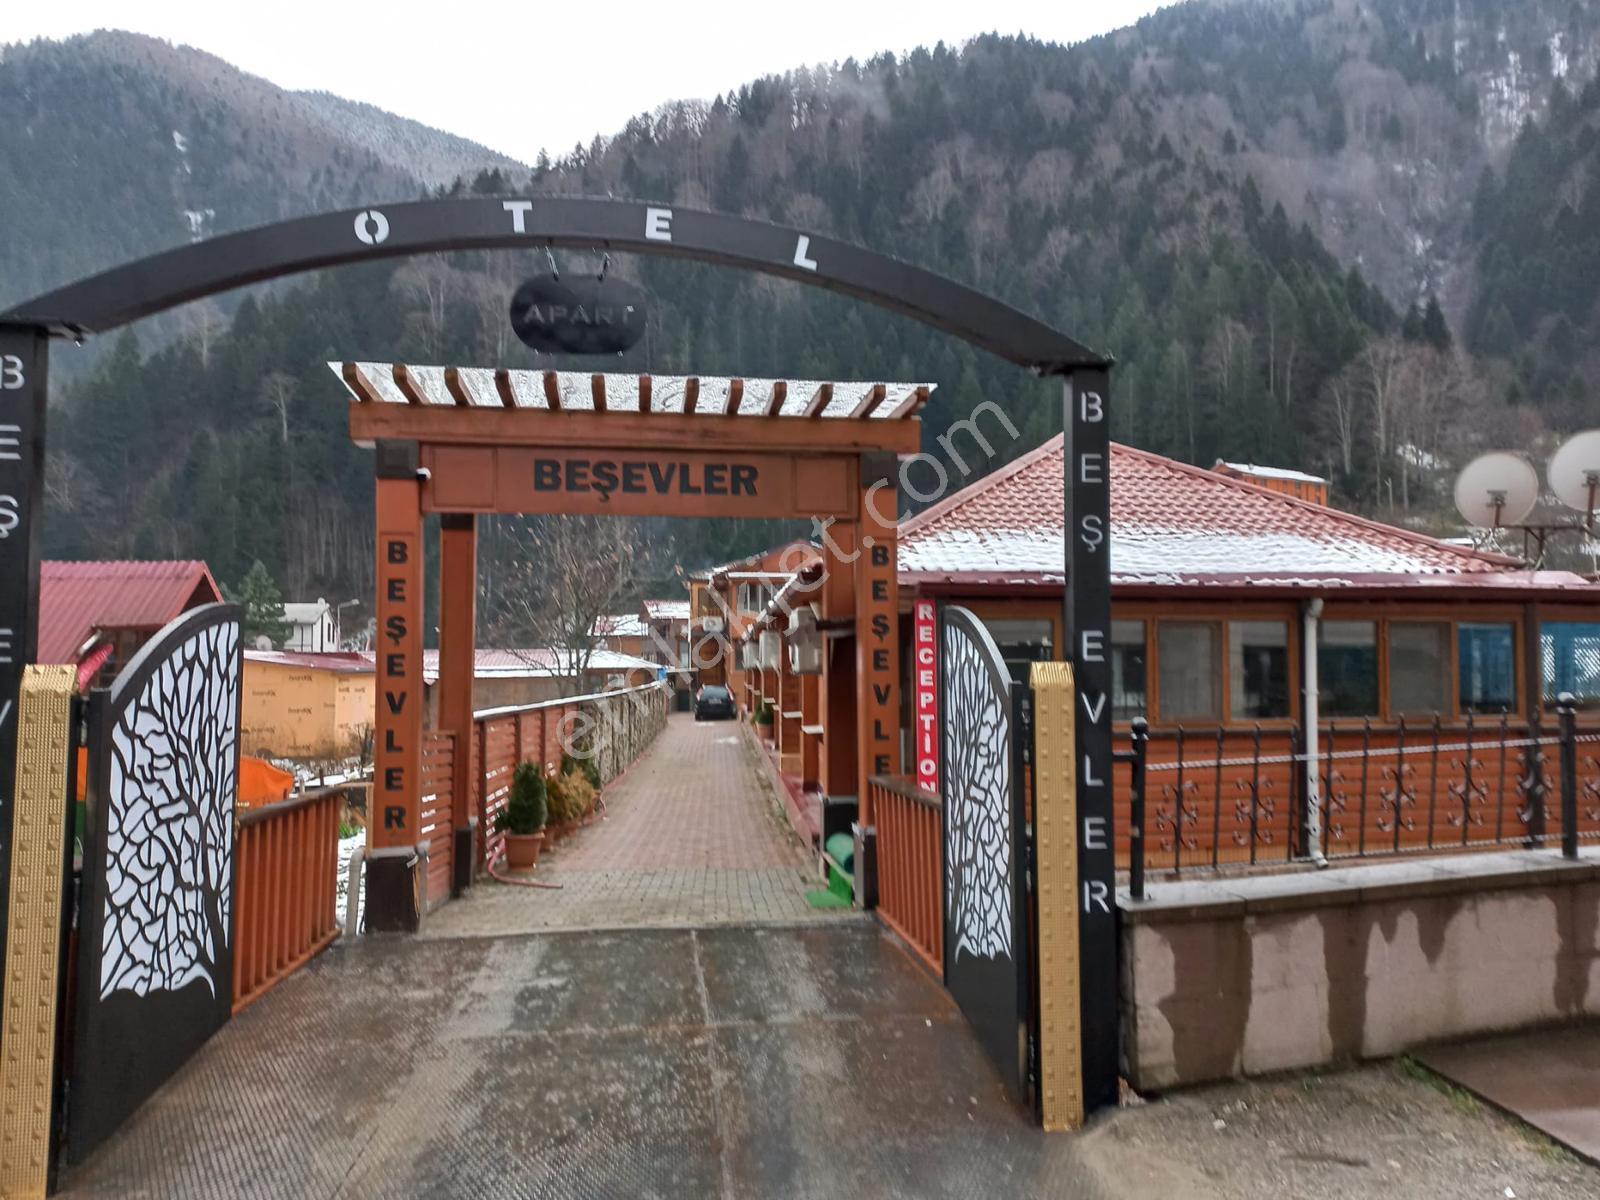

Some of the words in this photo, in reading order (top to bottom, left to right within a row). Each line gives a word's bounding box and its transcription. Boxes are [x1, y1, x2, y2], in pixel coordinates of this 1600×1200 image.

[353, 200, 818, 272] OTEL
[523, 304, 635, 325] APART
[533, 459, 759, 500] BEŞEVLER
[384, 540, 409, 830] BEŞEVLER
[871, 545, 892, 776] BEŞEVLE
[918, 603, 937, 794] RECEPTION
